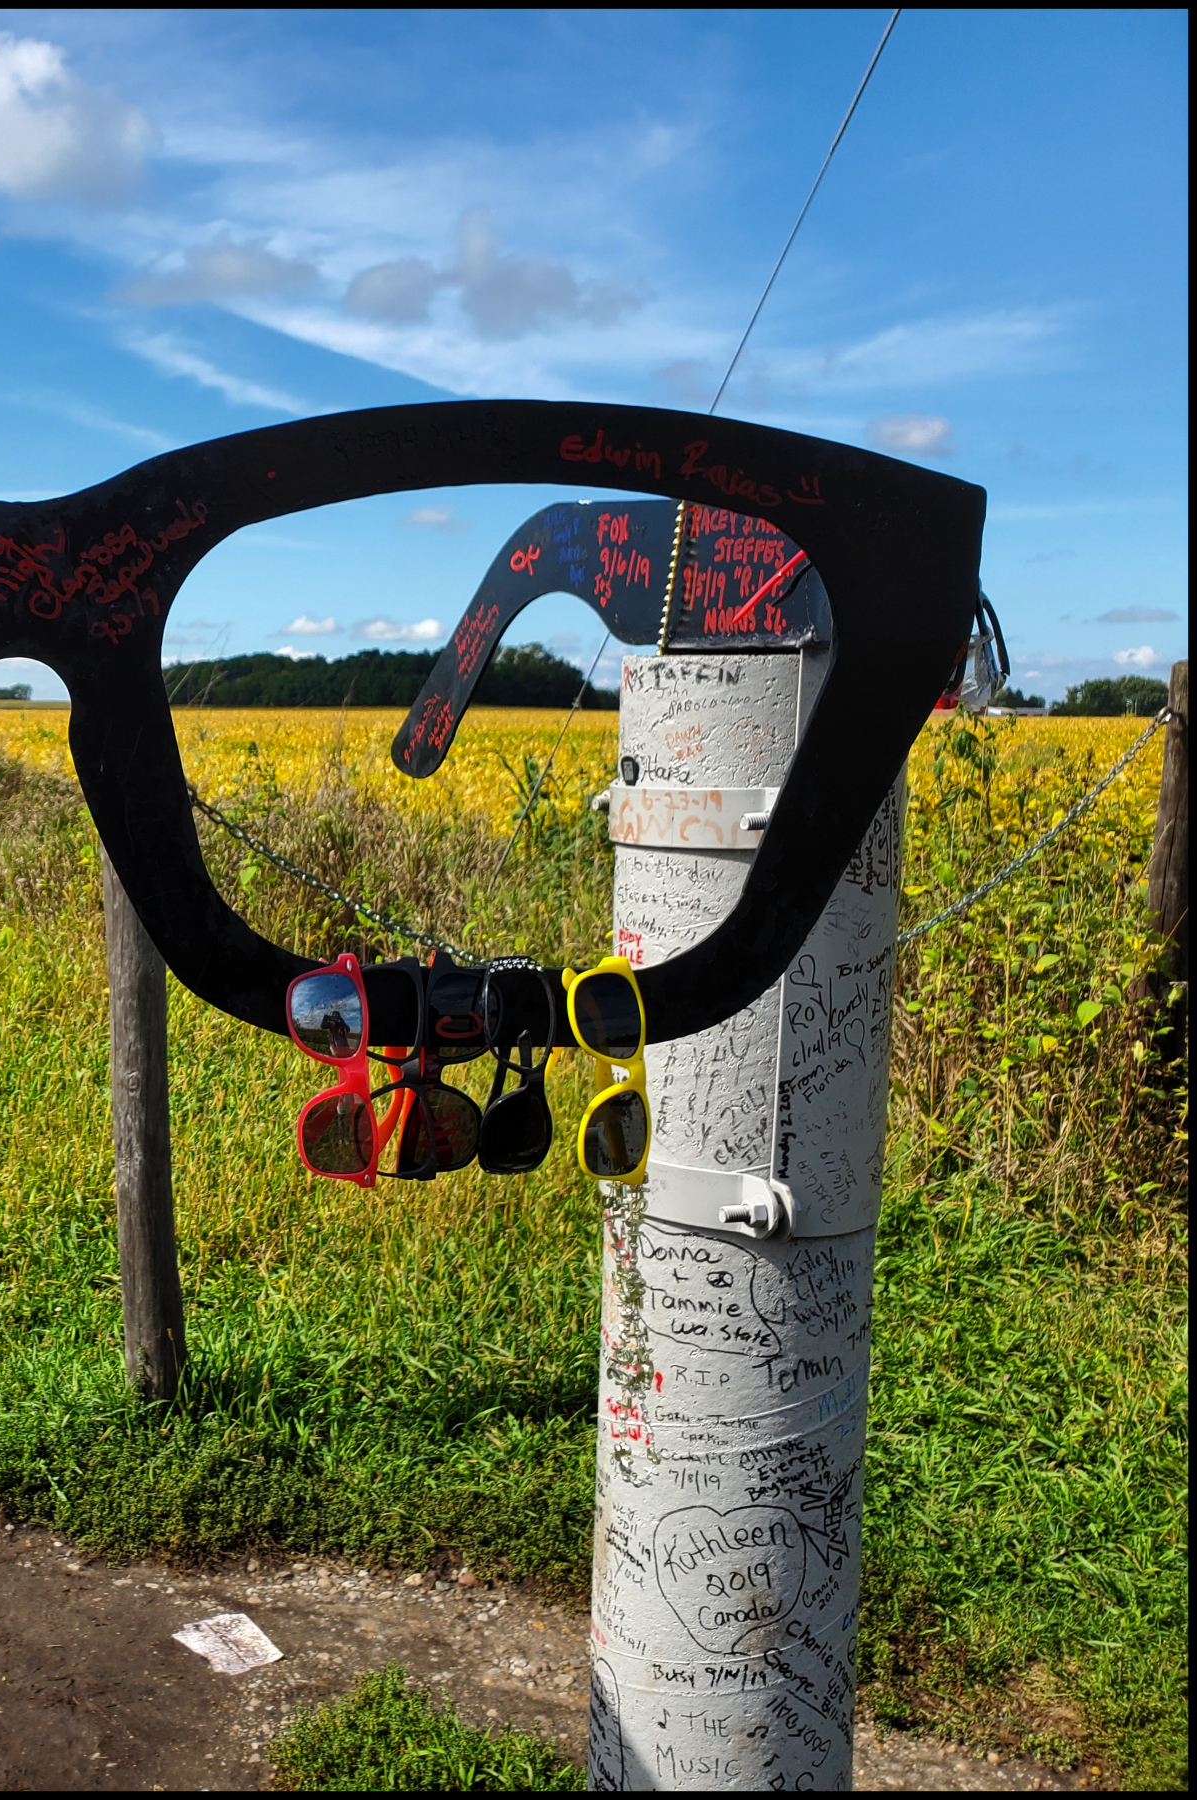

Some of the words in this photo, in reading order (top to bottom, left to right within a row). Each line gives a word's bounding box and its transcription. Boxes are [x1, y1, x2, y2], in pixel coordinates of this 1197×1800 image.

[560, 431, 662, 479] Edwin
[682, 441, 783, 507] Rojas
[597, 512, 630, 547] FOX
[600, 547, 651, 589] 9/6/19
[714, 536, 785, 570] STEFFES
[683, 562, 728, 611] 9/5/19
[641, 788, 723, 813] 6-23-19
[835, 960, 865, 981] TOM
[803, 1056, 854, 1105] Florida
[640, 1232, 723, 1265] Donna
[645, 1285, 744, 1318] Tammie
[758, 1442, 829, 1482] Everett
[747, 1465, 814, 1503] Baytown
[706, 1562, 774, 1599] 2019
[697, 1600, 785, 1632] Canada
[785, 1619, 835, 1669] Charlie
[763, 1647, 816, 1697] George
[680, 1709, 735, 1739] THE
[655, 1742, 743, 1780] MUSIC
